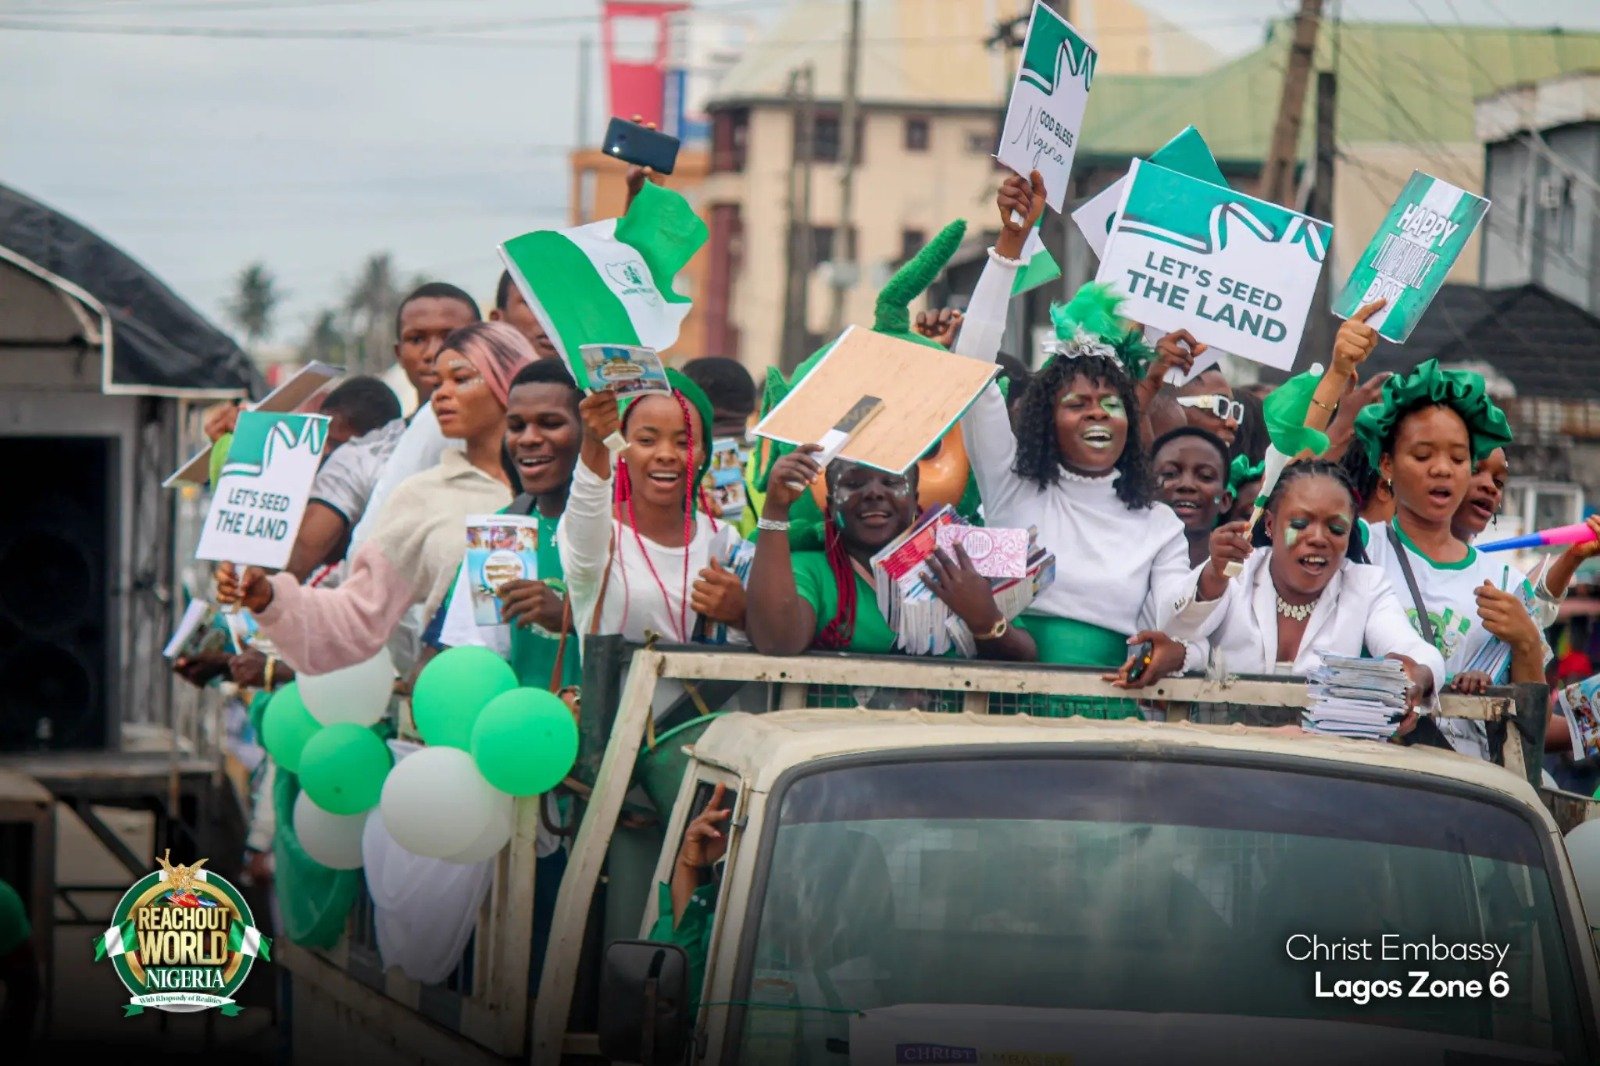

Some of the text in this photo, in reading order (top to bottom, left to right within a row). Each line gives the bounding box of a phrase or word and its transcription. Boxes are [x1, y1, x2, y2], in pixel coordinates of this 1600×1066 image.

[1011, 104, 1066, 170] Nigeria
[1040, 110, 1074, 148] GOD BLESS
[1396, 203, 1460, 247] HAPPY
[1145, 251, 1283, 312] LET'S SEED
[1127, 269, 1288, 343] THE LAND
[228, 488, 290, 512] LET'S SEED
[216, 510, 288, 541] THE LAND
[904, 1047, 972, 1061] CHRIST
